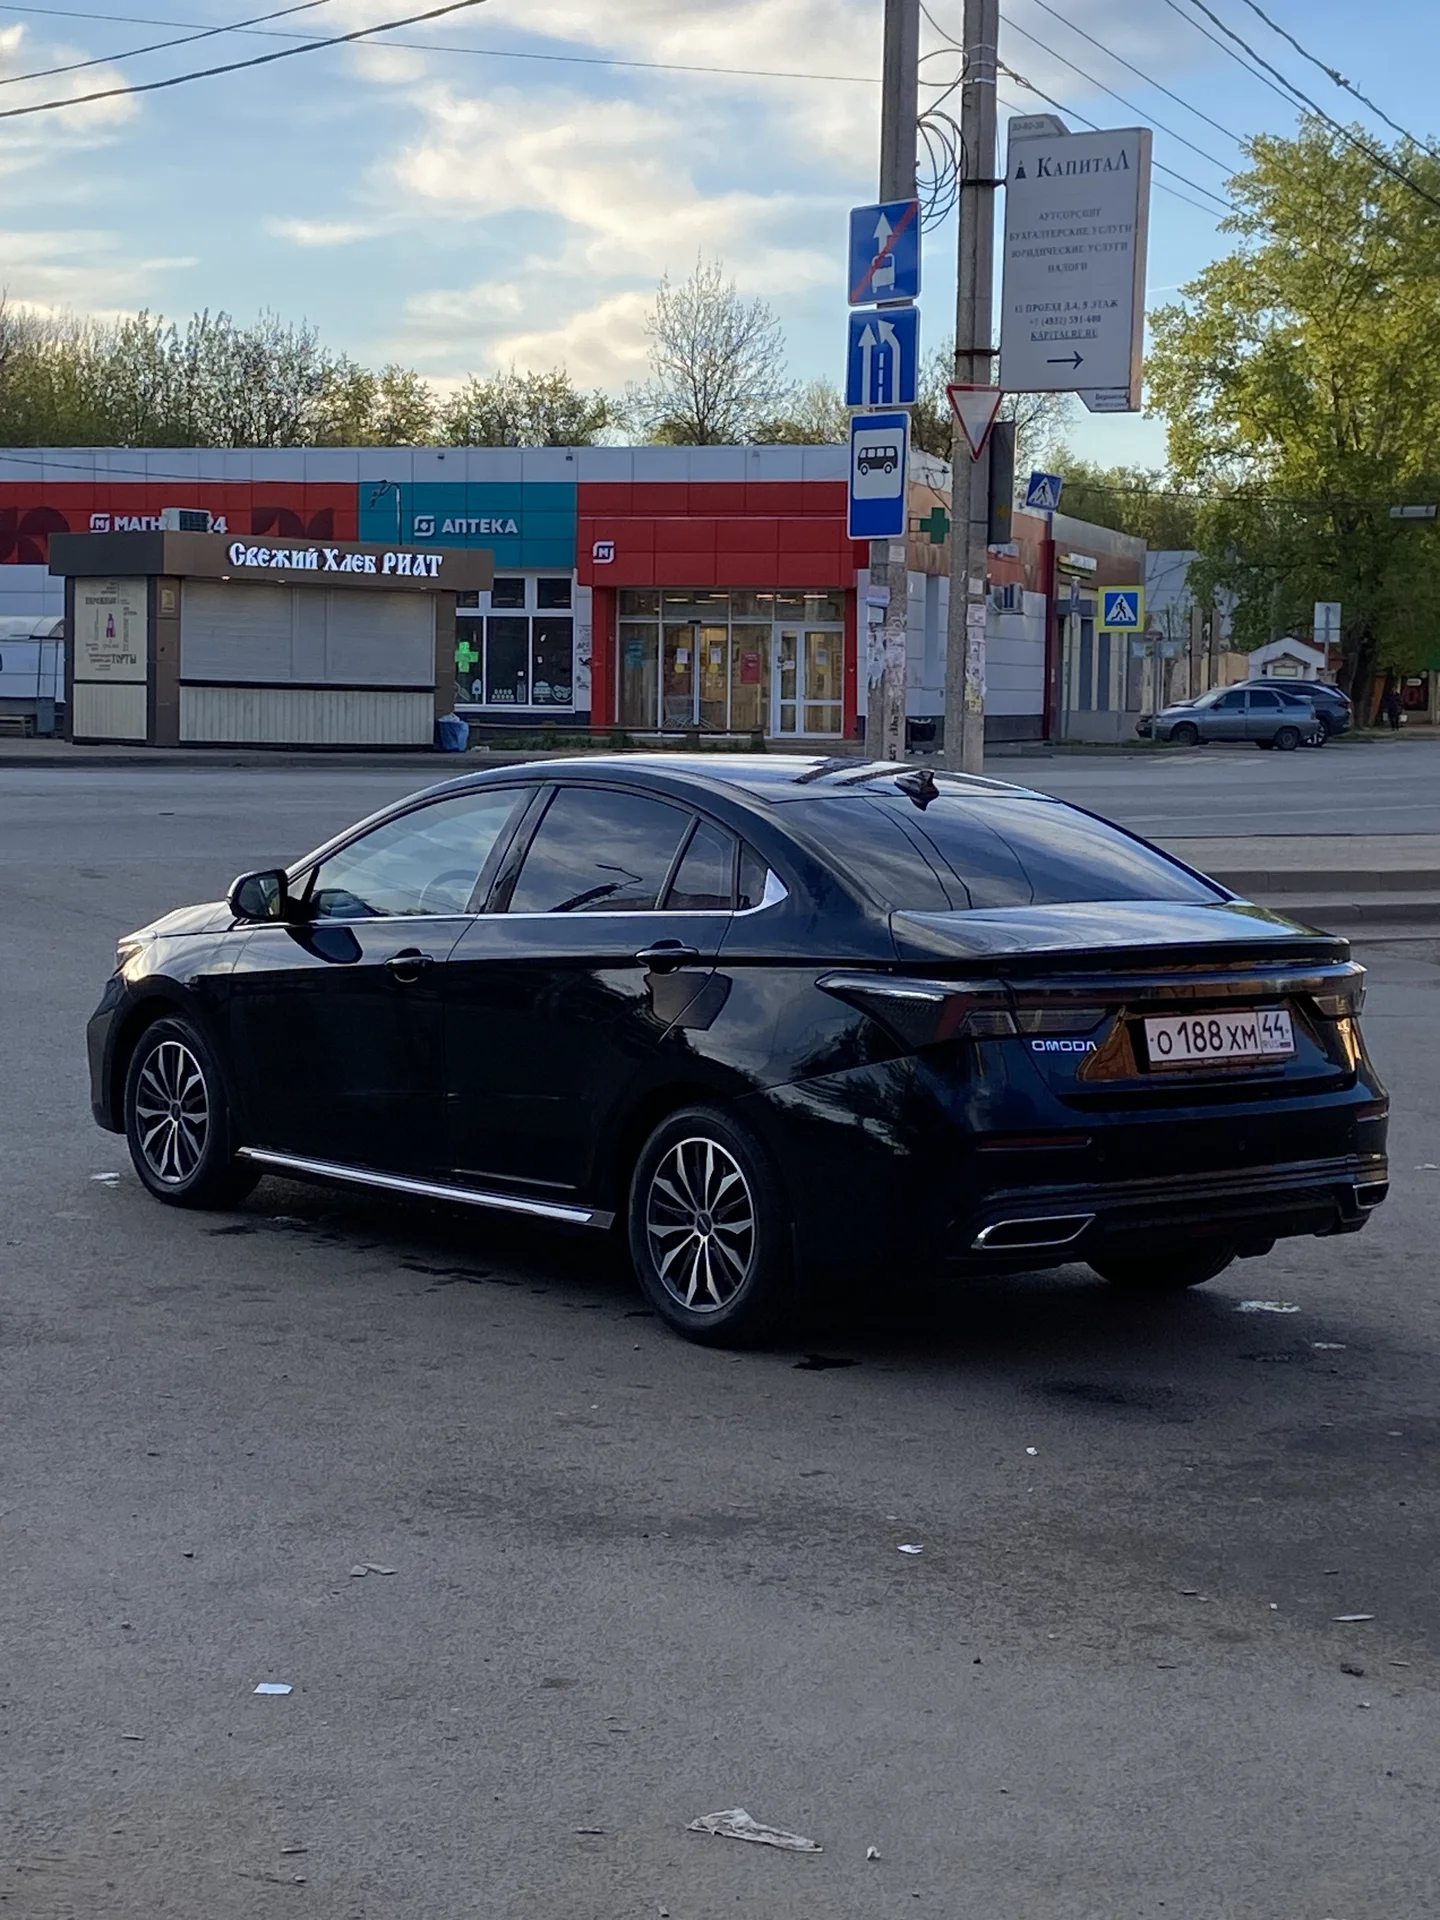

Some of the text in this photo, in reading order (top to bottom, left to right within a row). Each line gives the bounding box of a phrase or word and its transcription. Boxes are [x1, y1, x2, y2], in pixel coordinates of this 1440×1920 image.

[1010, 223, 1132, 241] БУХГАЛТЕРСКИЕ УСЛУГИ
[1012, 242, 1128, 258] ЮРИДИЧЕСКИЕ УСЛУГИ
[1048, 262, 1088, 273] НАЛОГИ
[1091, 299, 1118, 309] ЭТАЖ
[441, 518, 518, 534] АПТЕКА
[381, 552, 443, 577] РИАТ
[1262, 1013, 1285, 1039] 44
[1031, 1040, 1098, 1051] OMODA
[1262, 1039, 1280, 1049] RUS
